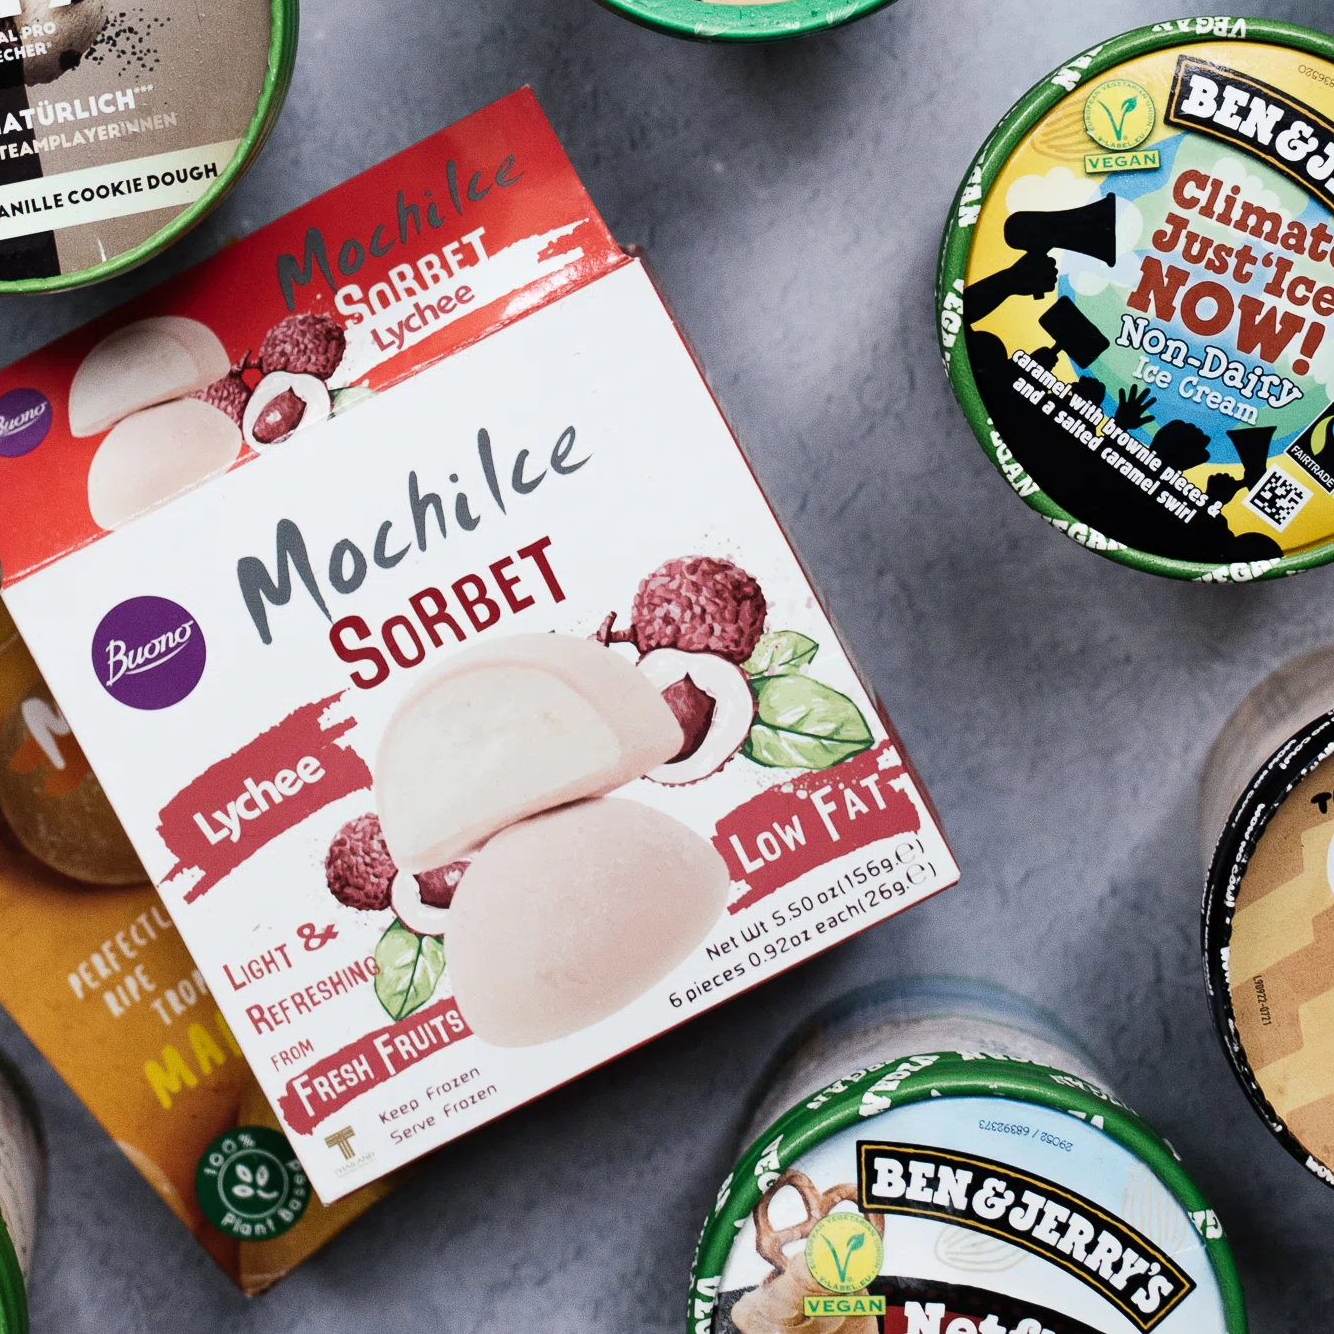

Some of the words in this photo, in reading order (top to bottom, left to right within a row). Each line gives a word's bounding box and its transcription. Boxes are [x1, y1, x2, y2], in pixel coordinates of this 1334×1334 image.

[21, 21, 56, 40] PRO
[1178, 74, 1272, 138] BEN
[1276, 119, 1313, 163] &
[67, 178, 144, 205] COOKIE
[147, 162, 218, 192] DOUGH
[370, 282, 476, 354] Lychee
[1127, 256, 1326, 377] NOW!
[1115, 314, 1305, 410] Non-Dairy
[1132, 358, 1175, 389] Ice
[1178, 374, 1260, 426] Cream
[1011, 349, 1070, 401] caramel
[1069, 389, 1105, 423] with
[1099, 413, 1163, 469] brownie
[1159, 456, 1211, 509] pieces
[1054, 408, 1102, 454] salted
[1156, 489, 1199, 524] swirl
[103, 620, 195, 687] Buono
[192, 749, 327, 850] Lychee
[298, 921, 340, 953] &
[705, 936, 738, 962] Net
[669, 993, 683, 1008] 6
[685, 962, 746, 1003] pieces
[378, 1094, 422, 1128] Keep
[424, 1065, 484, 1103] Frozen
[871, 1158, 970, 1208] BEN
[971, 1177, 1014, 1220] &
